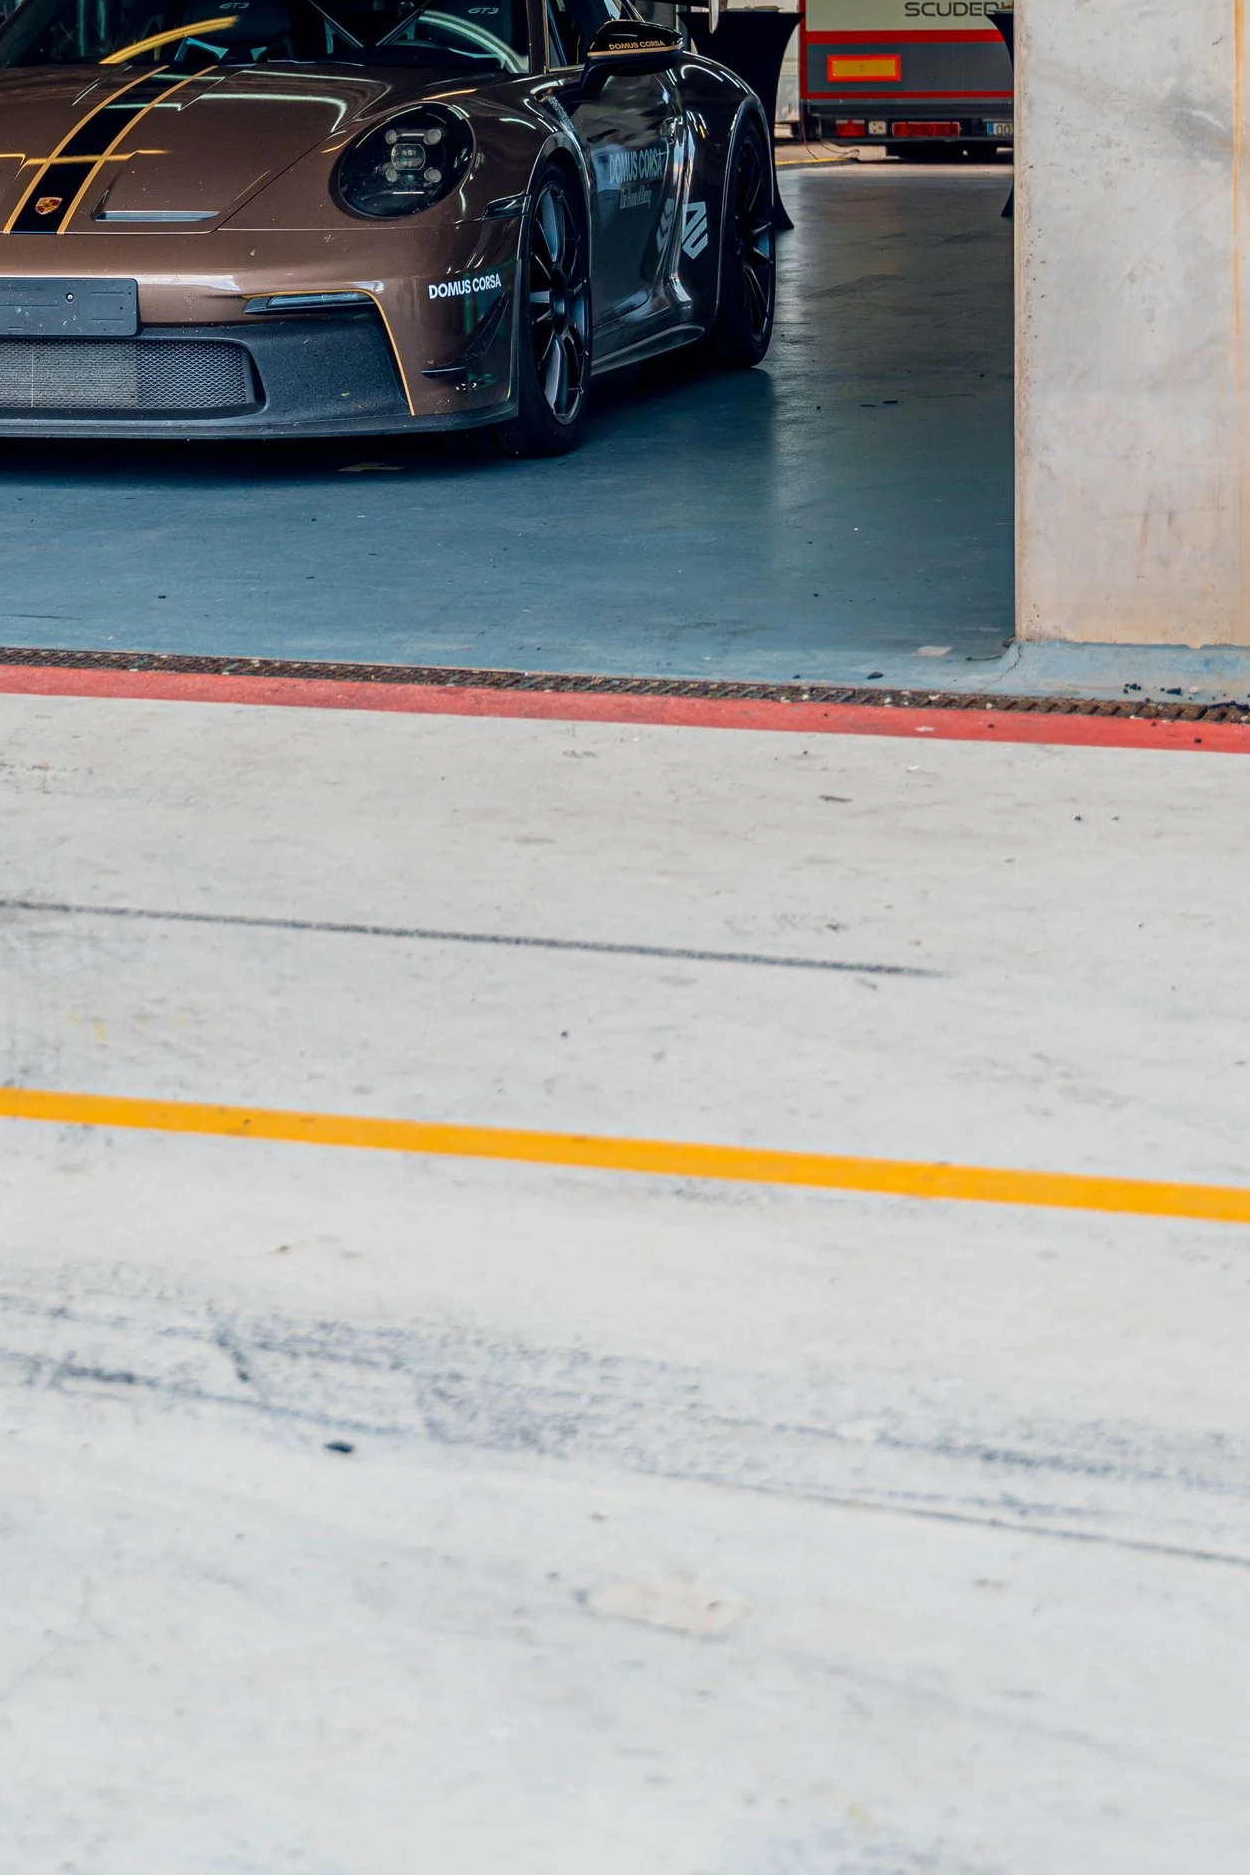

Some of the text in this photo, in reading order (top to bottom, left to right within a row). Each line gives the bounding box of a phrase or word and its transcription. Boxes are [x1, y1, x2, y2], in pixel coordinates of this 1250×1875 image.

[219, 2, 250, 10] GT3
[467, 7, 499, 15] GT3
[904, 1, 1014, 17] SCUDER
[608, 40, 666, 51] DOMUS CORSA
[609, 147, 663, 185] DOMUS CORSA
[428, 273, 502, 299] DOMUS CORSA
